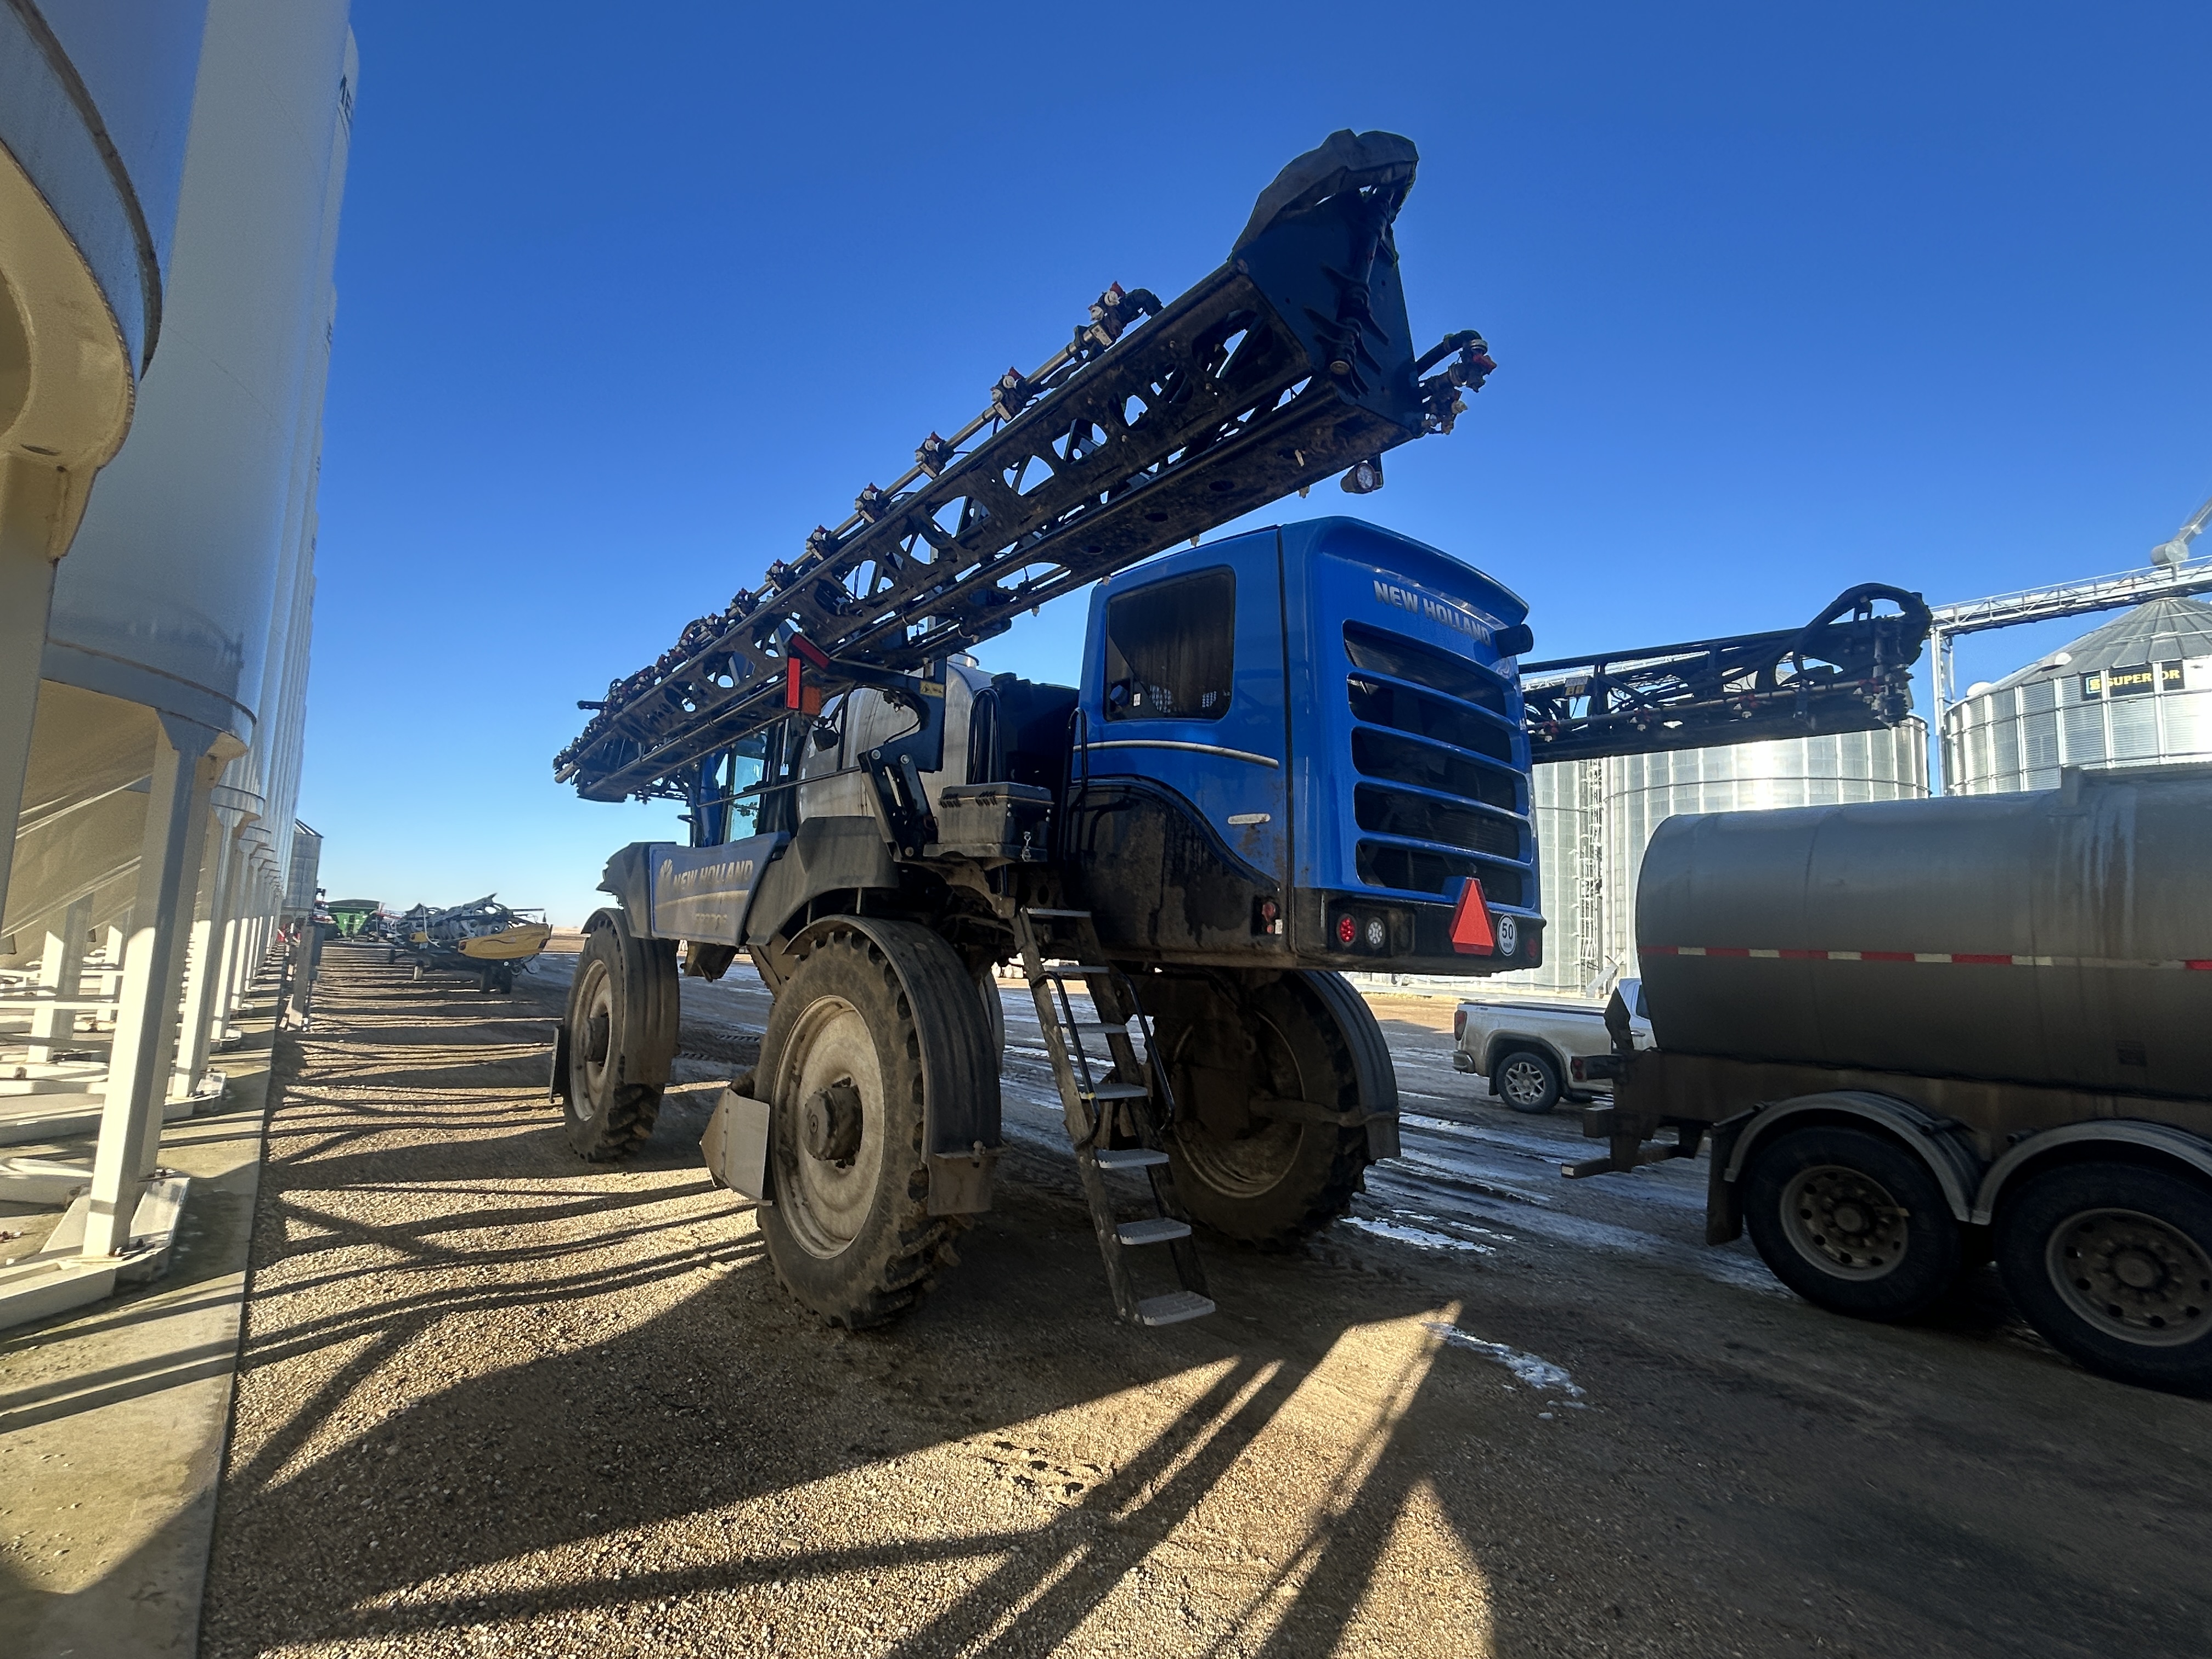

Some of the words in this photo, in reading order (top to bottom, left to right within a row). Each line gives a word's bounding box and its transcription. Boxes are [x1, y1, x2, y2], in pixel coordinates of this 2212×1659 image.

[1373, 580, 1418, 614] NEW
[1423, 597, 1491, 647] HOLLAND
[2107, 669, 2180, 687] SUPEROR
[1502, 922, 1514, 940] 50
